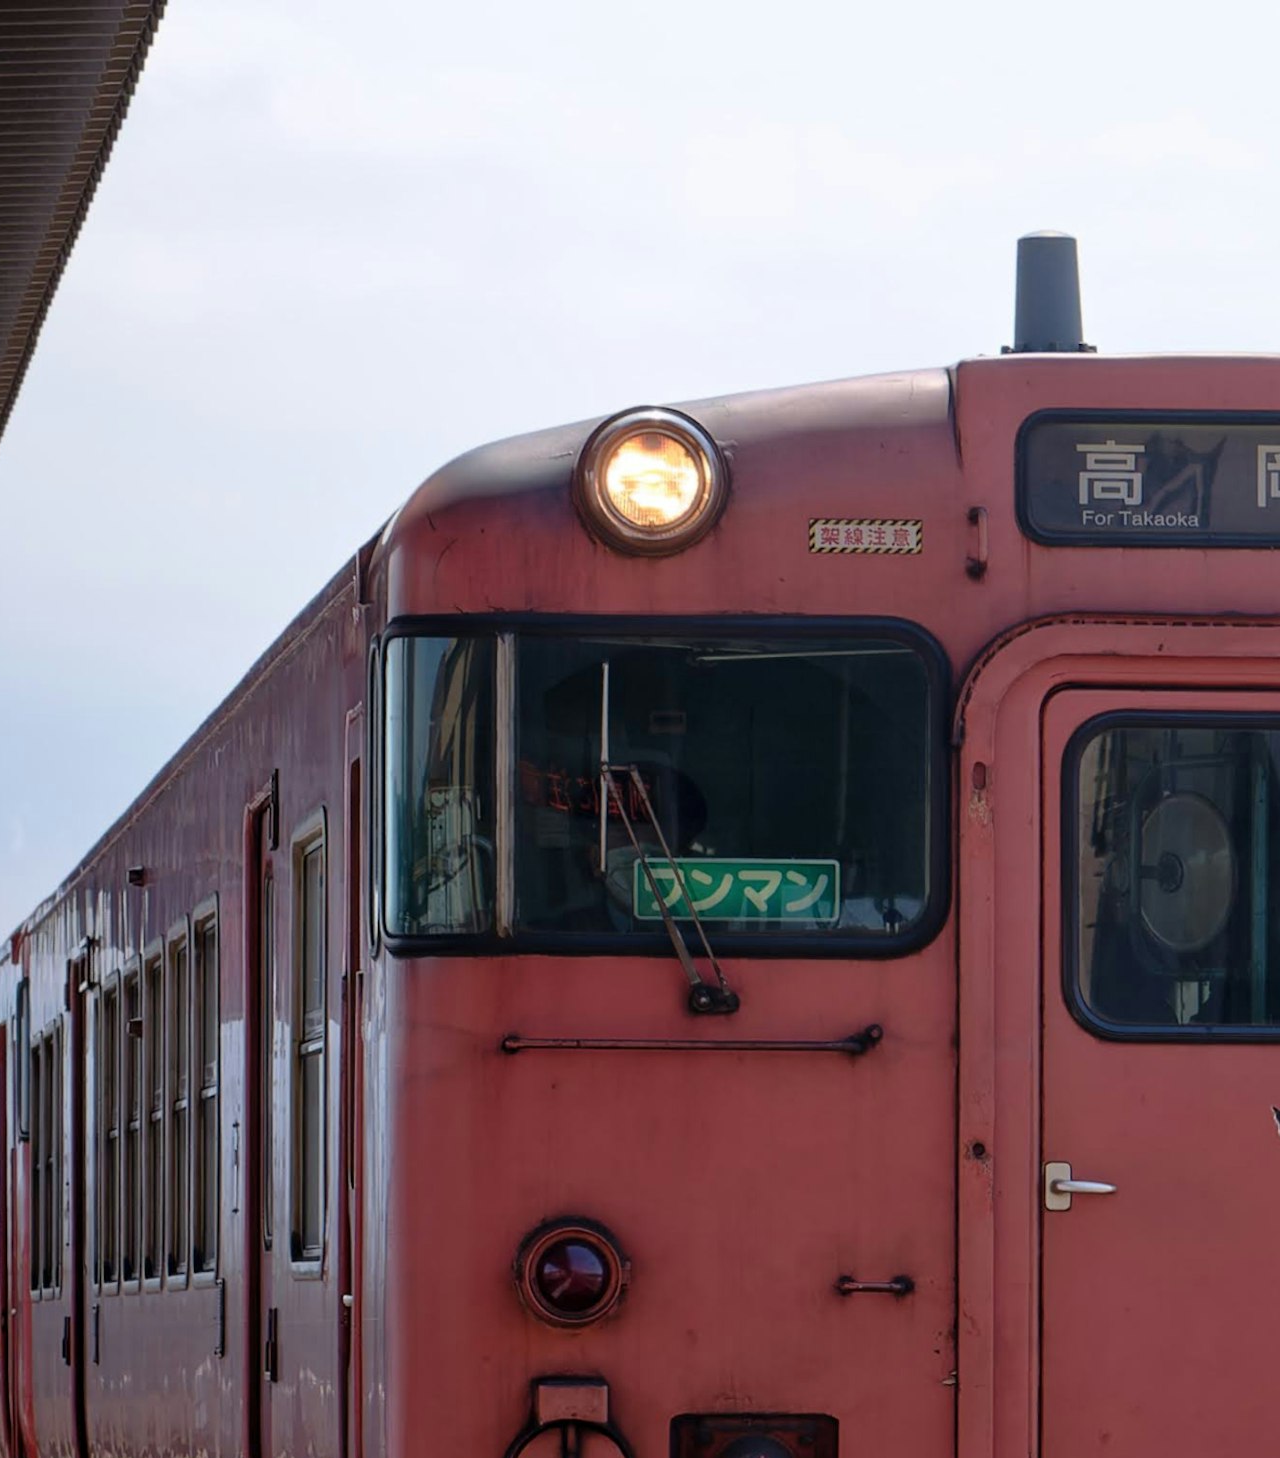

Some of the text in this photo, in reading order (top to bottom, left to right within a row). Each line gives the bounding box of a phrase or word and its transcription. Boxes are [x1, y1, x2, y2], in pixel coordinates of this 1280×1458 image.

[1082, 510, 1199, 527] For Takaoka
[821, 527, 910, 547] 架線注意
[644, 868, 829, 912] ワンマン
